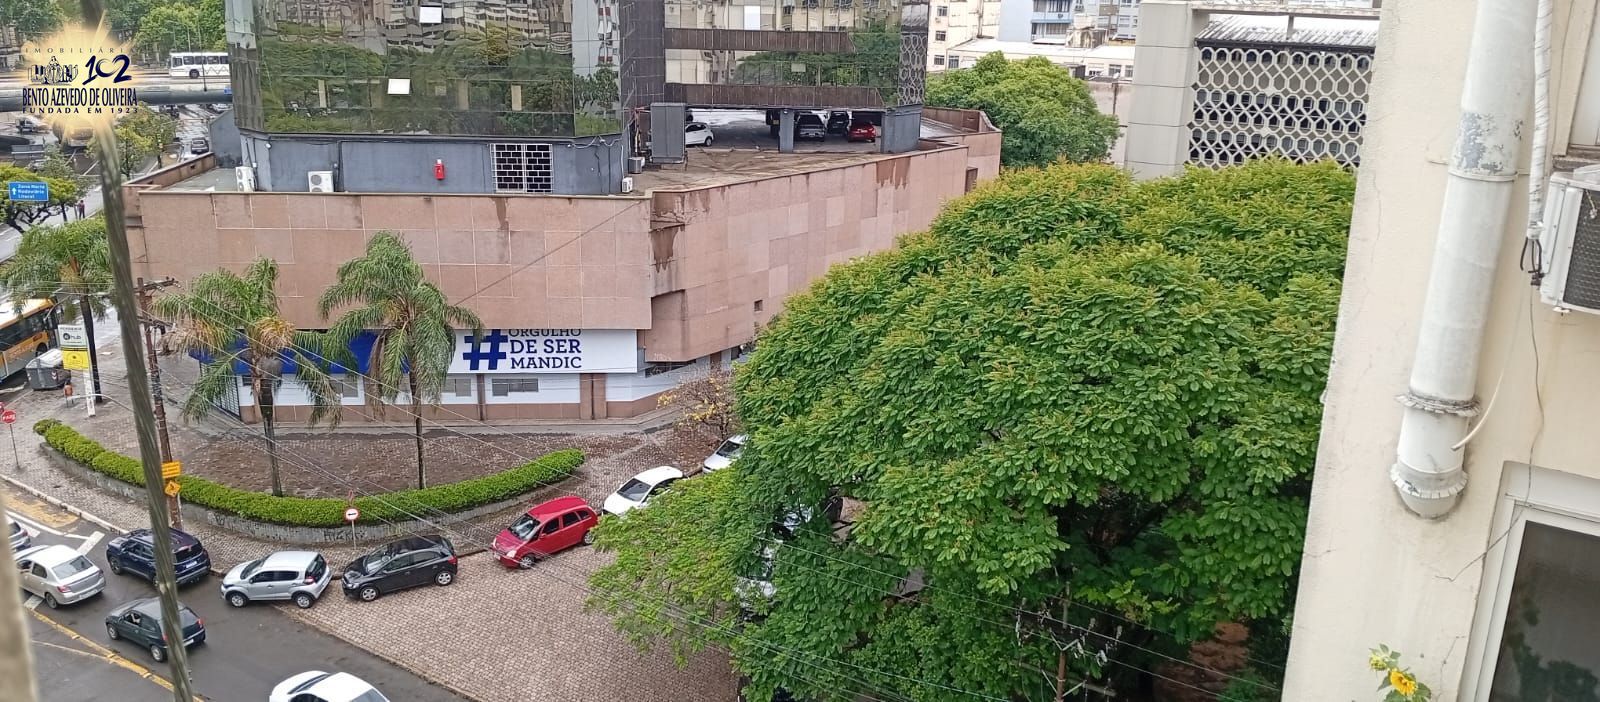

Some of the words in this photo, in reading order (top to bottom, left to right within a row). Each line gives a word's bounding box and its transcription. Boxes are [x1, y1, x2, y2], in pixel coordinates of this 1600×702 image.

[508, 329, 582, 337] ORGULHO
[510, 339, 538, 354] DE
[543, 339, 582, 354] SER
[511, 356, 582, 369] MANDIC
